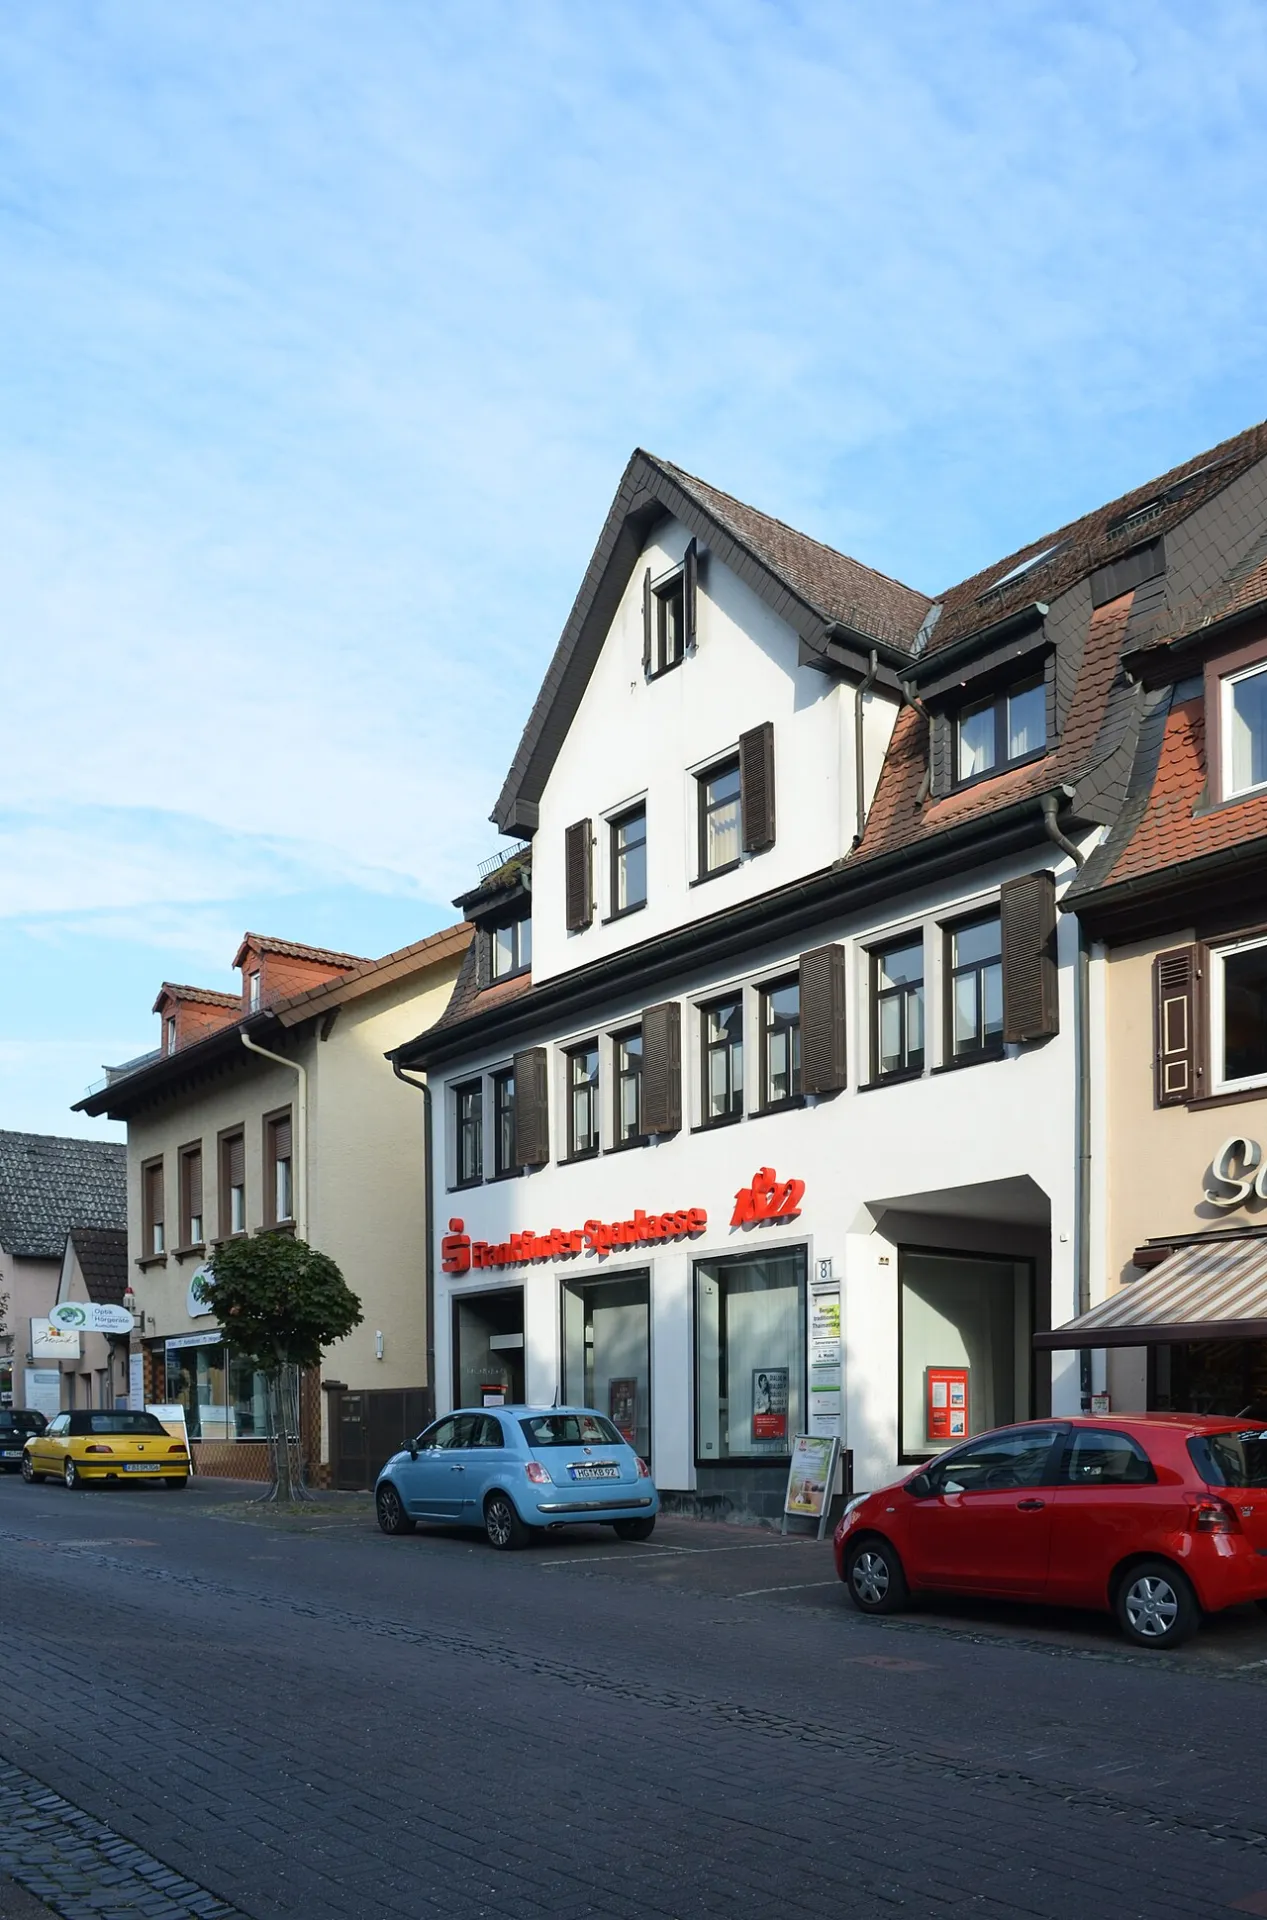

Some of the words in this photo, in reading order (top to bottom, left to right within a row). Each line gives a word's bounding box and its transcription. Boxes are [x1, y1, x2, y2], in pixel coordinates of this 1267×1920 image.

[729, 1166, 806, 1227] 1822
[472, 1228, 585, 1268] Frankfurter
[584, 1208, 707, 1256] Sparkasse
[820, 1261, 832, 1279] 81
[94, 1308, 113, 1316] Optik
[577, 1469, 589, 1477] HG
[593, 1469, 604, 1477] KB
